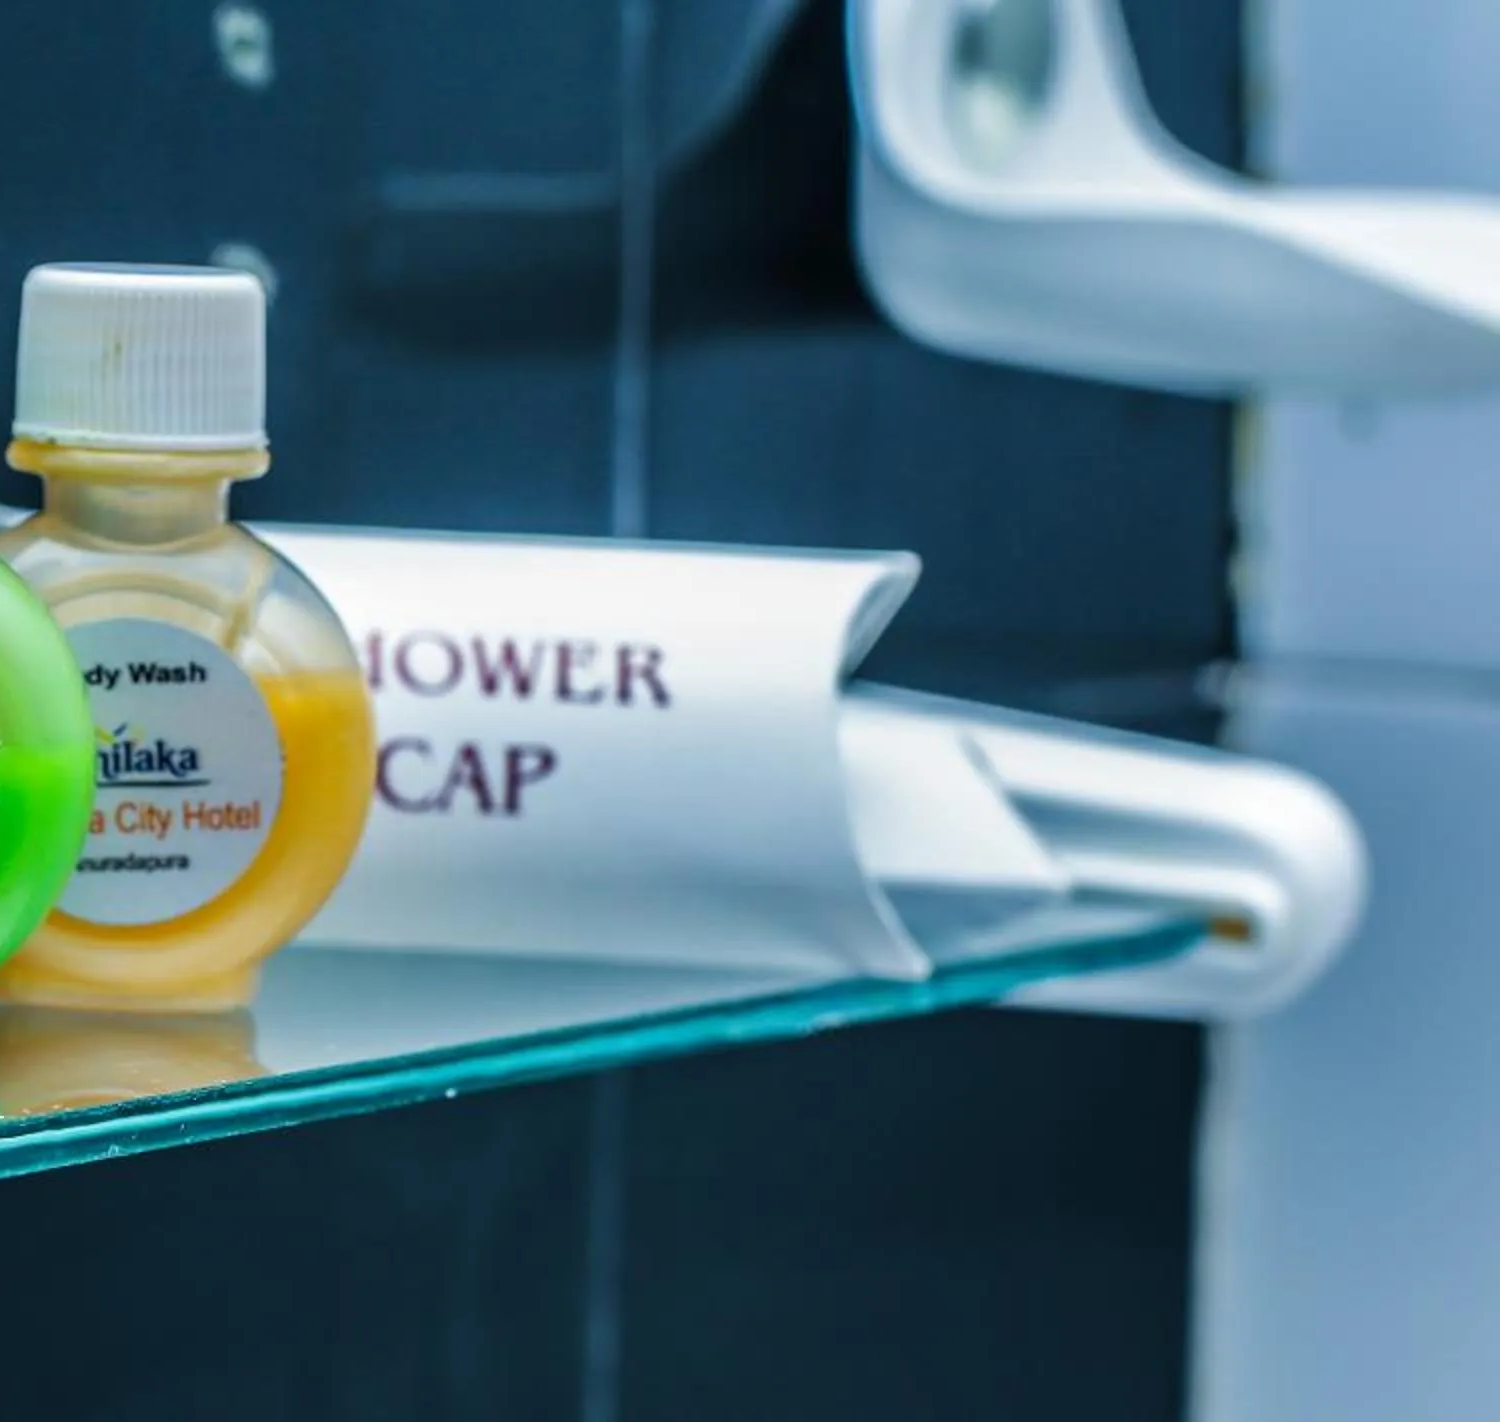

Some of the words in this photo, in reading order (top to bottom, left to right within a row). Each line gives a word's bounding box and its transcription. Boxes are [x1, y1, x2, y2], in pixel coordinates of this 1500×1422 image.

[84, 665, 120, 690] dy
[128, 661, 207, 684] Wash
[367, 628, 674, 710] OWER
[374, 735, 560, 819] CAP
[114, 801, 171, 840] City
[182, 801, 261, 831] Hotel
[75, 852, 189, 874] nuradapura
